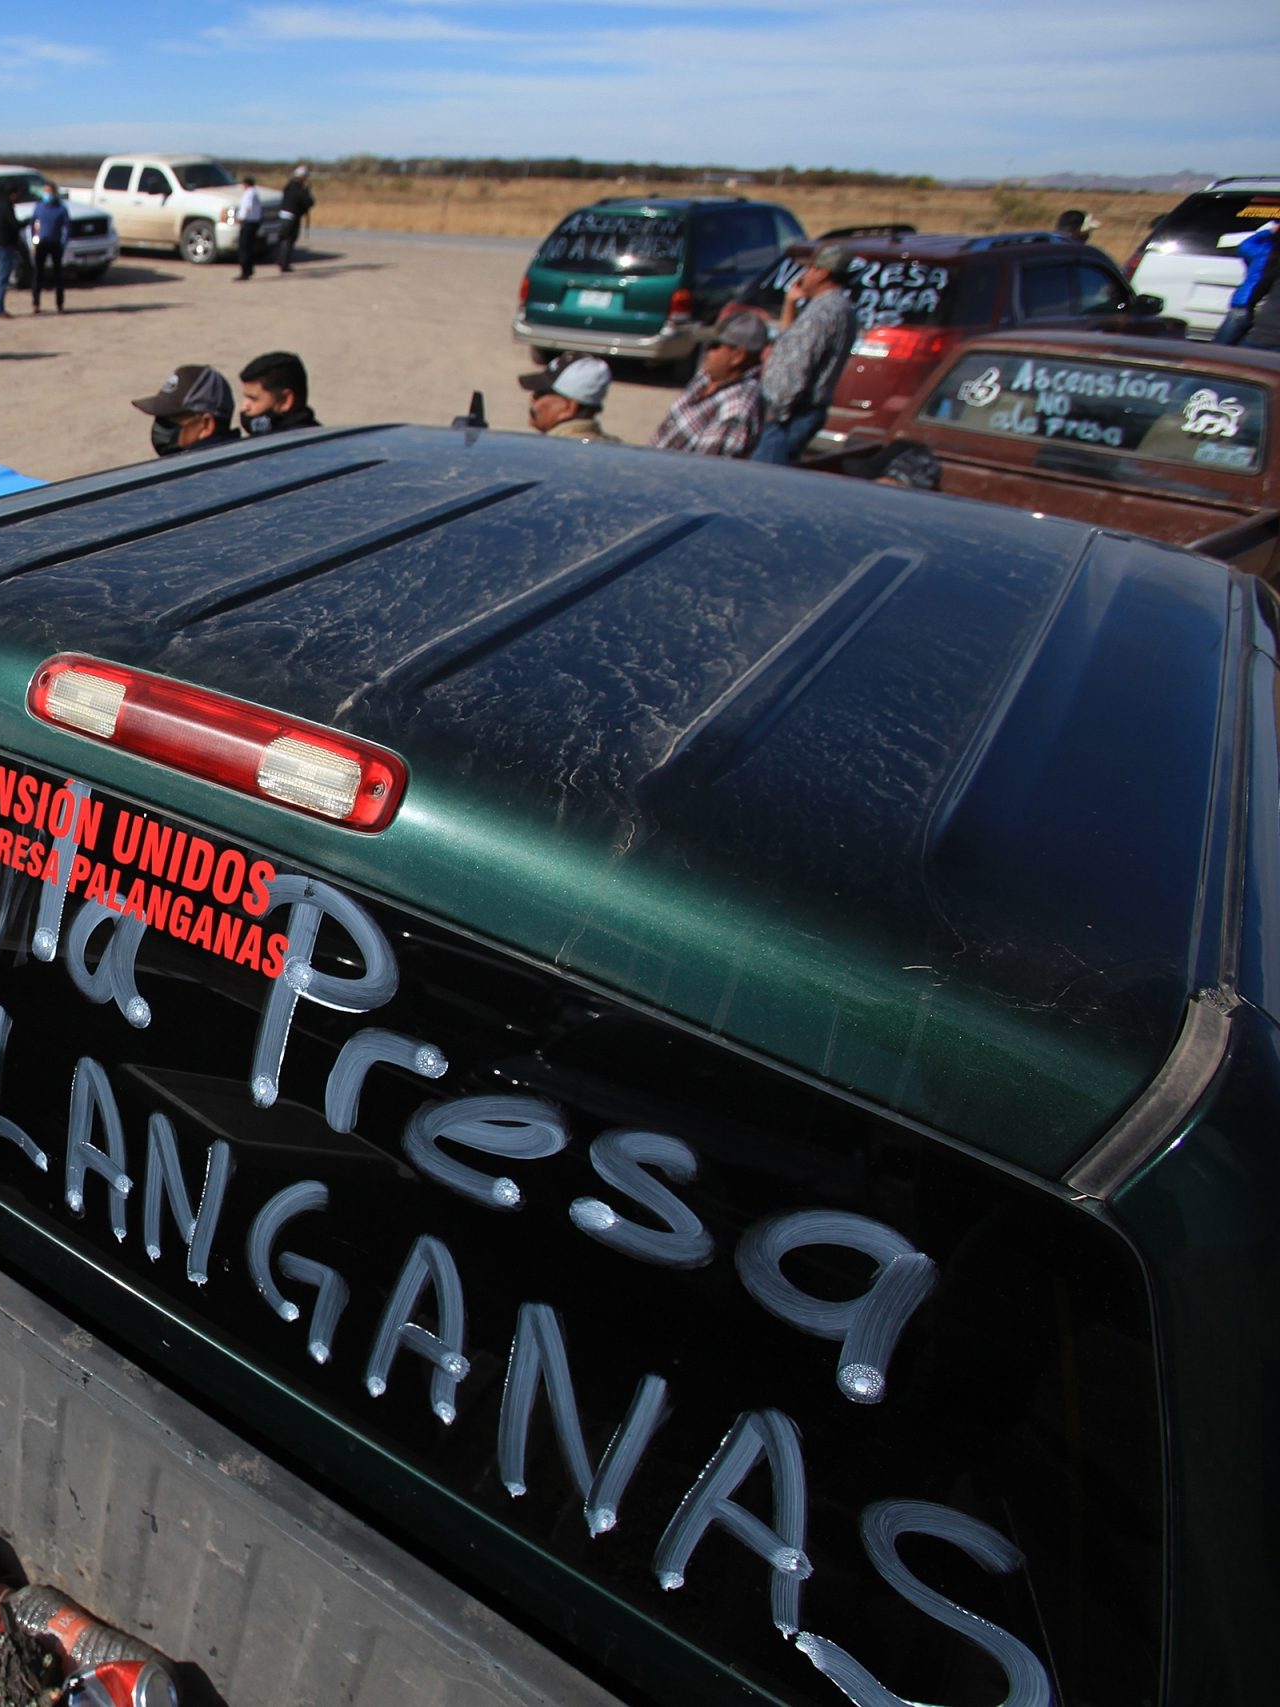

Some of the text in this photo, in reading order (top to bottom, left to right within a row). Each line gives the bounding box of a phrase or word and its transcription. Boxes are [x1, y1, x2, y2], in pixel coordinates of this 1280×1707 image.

[1035, 393, 1071, 417] NO
[68, 854, 289, 979] PALANGANAS
[112, 810, 276, 917] UNIDOS
[252, 874, 940, 1405] Presa
